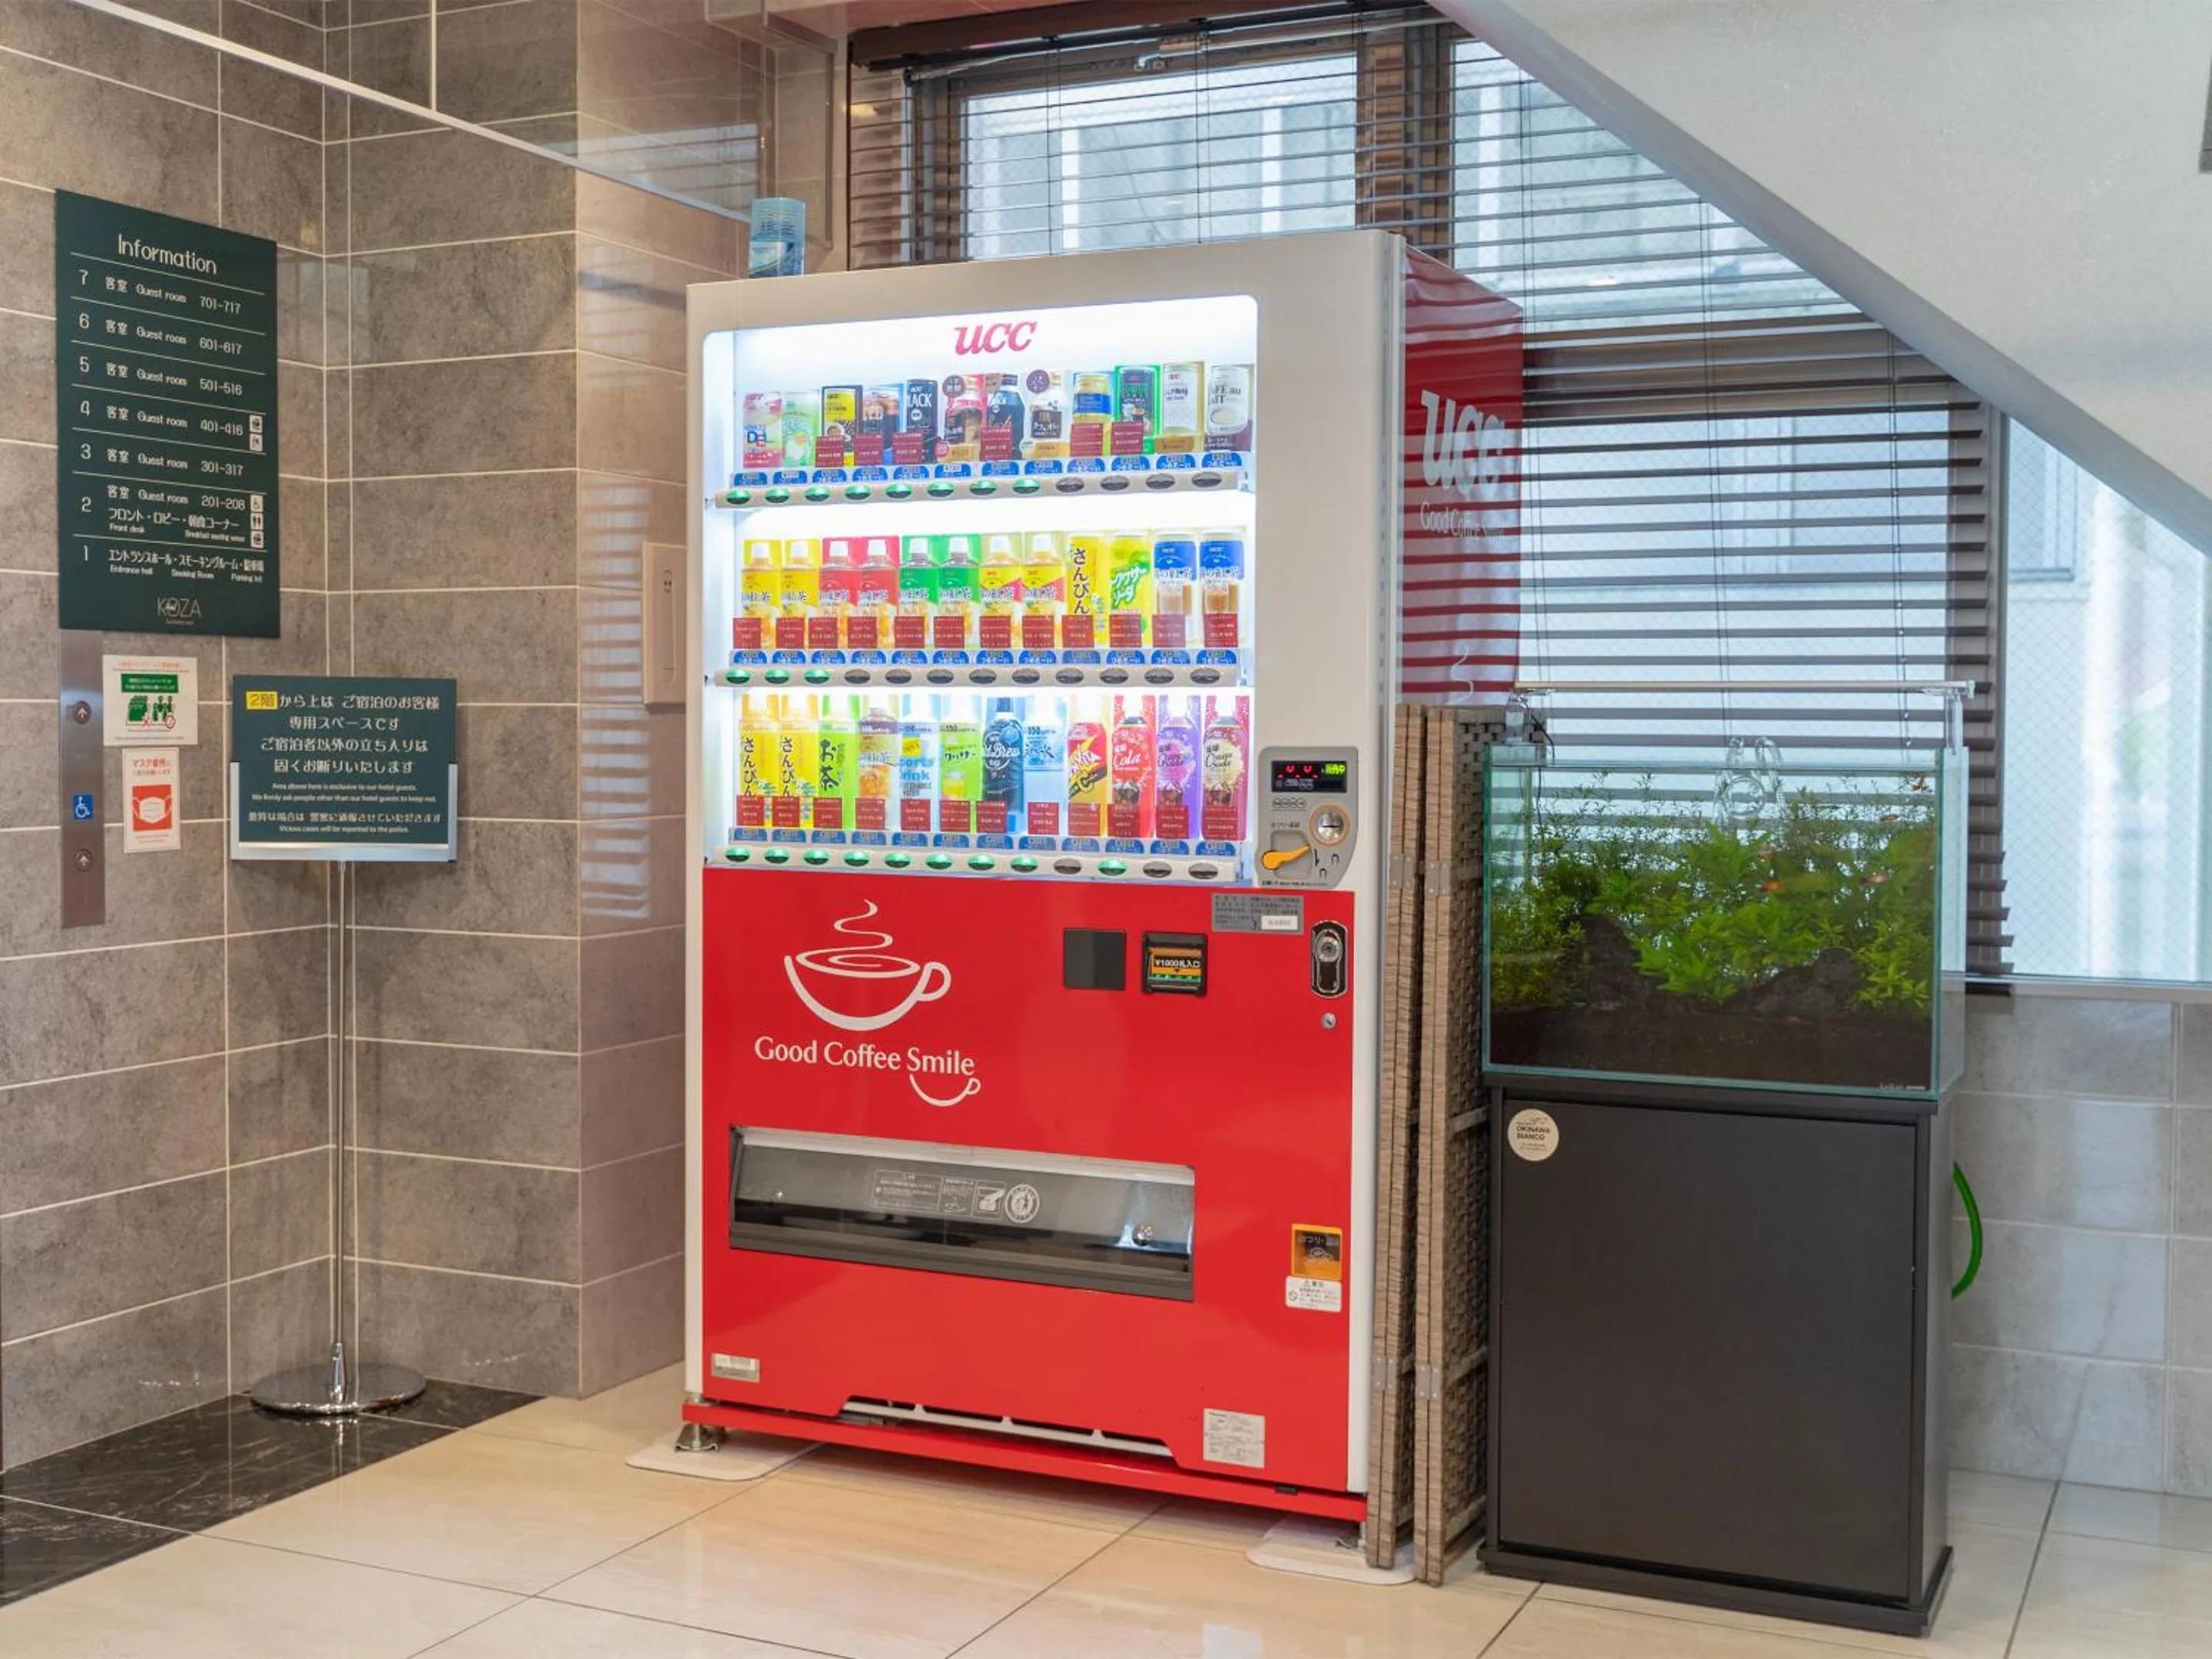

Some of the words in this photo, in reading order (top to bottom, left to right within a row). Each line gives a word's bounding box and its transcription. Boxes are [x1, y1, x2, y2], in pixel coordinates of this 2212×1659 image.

[118, 233, 217, 275] Information
[79, 269, 88, 285] 7
[136, 283, 162, 299] Guest
[164, 292, 187, 303] room
[78, 313, 89, 329] 6
[136, 326, 163, 341] Guest
[165, 333, 187, 345] room
[79, 356, 89, 373] 5
[137, 369, 163, 382] Guest
[166, 376, 187, 386] room
[80, 400, 91, 417] 4
[137, 410, 164, 425] Guest
[166, 418, 188, 429] room
[81, 443, 91, 460] 3
[137, 452, 164, 466] Guest
[167, 459, 188, 469] room
[81, 496, 91, 513] 2
[138, 489, 165, 502] Guest
[167, 496, 189, 505] room
[83, 545, 88, 561] 1
[343, 694, 440, 710] ご宿泊のお客様
[289, 716, 399, 730] 専用スペースです
[261, 737, 429, 753] ご宿泊者以外の立ち入りは
[273, 759, 414, 774] 固くお断りいたします
[1114, 750, 1141, 767] Cola
[754, 1035, 818, 1064] Good
[823, 1041, 902, 1071] Coffee
[906, 1046, 975, 1076] Smile
